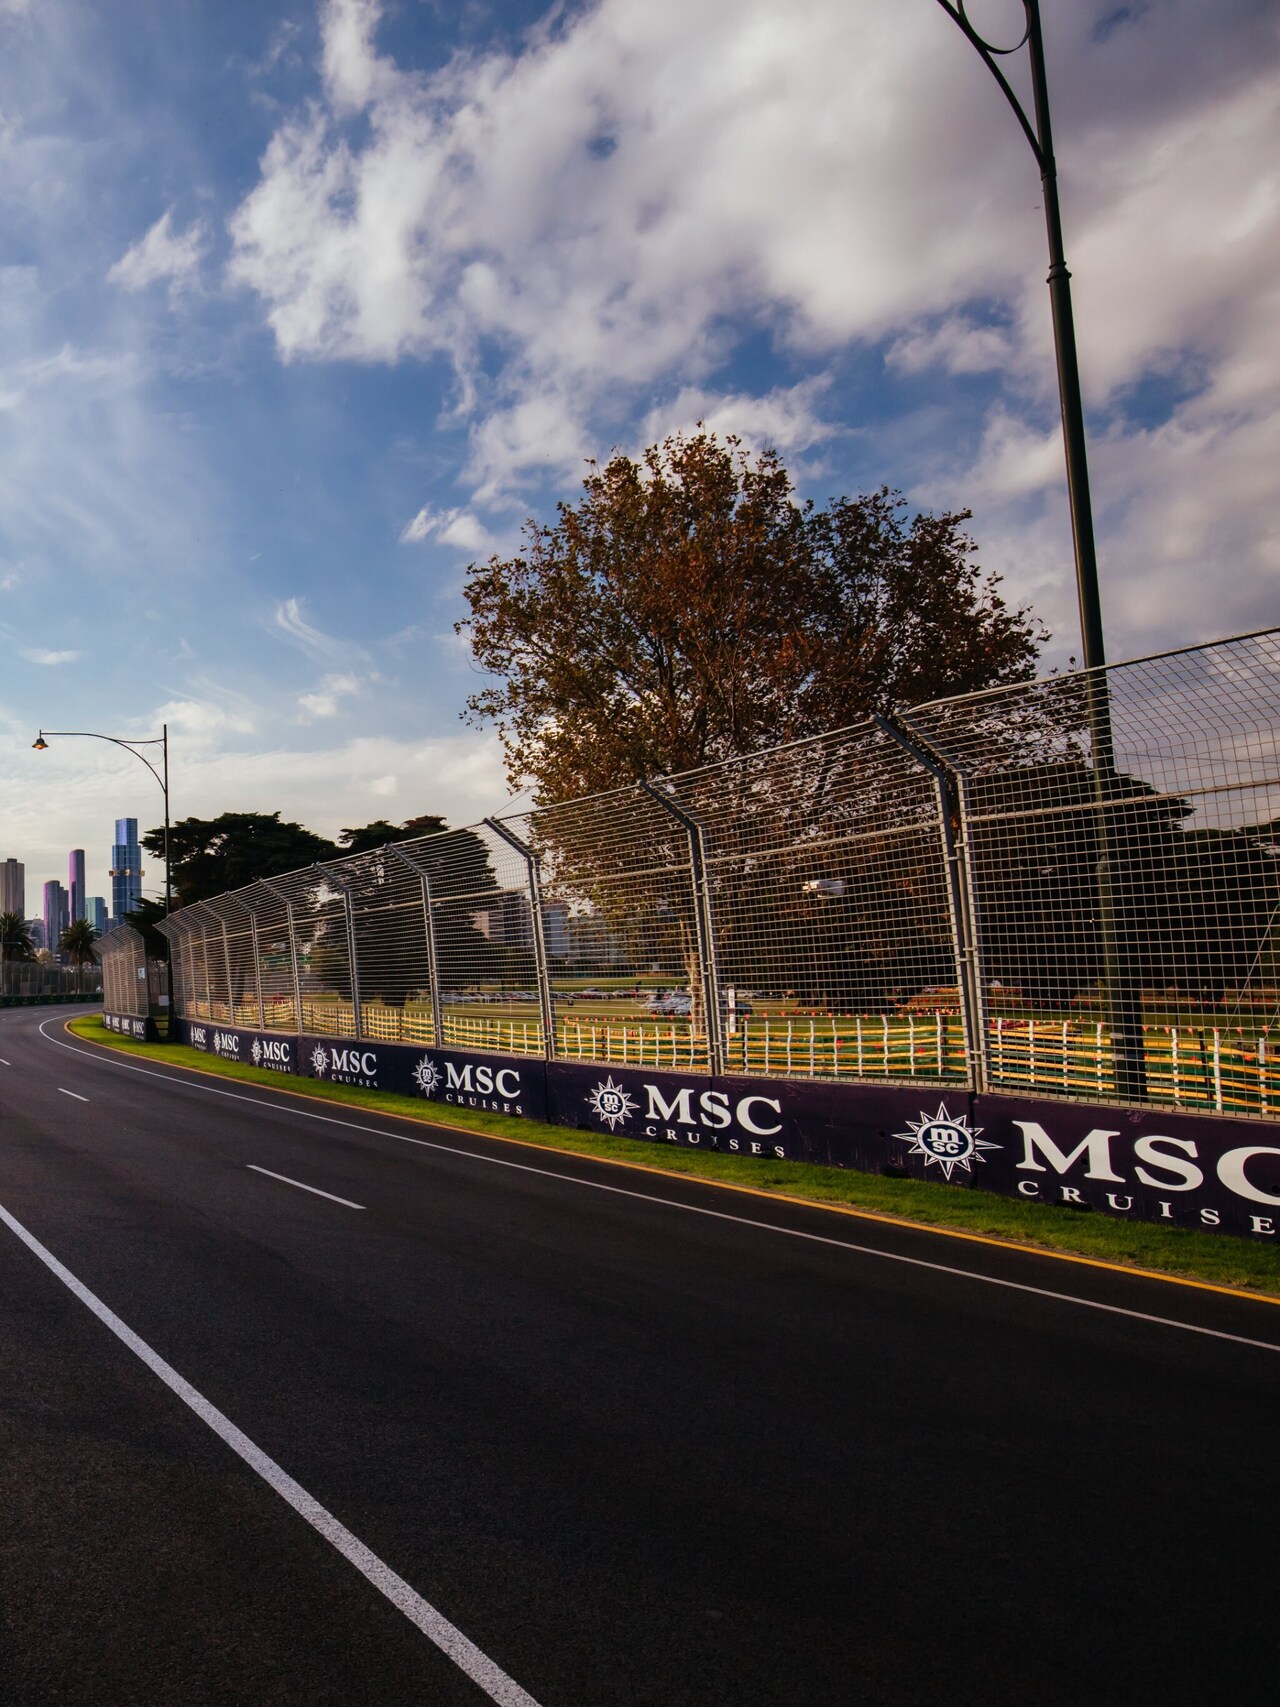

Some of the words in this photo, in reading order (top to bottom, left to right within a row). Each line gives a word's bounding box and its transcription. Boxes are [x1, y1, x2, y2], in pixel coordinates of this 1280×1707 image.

[194, 1027, 206, 1043] MSC
[221, 1033, 239, 1052] MSC
[263, 1041, 290, 1062] MSC
[331, 1049, 376, 1075] MSC
[332, 1074, 378, 1087] CRUISES
[444, 1062, 520, 1098] MSC
[446, 1094, 522, 1114] CRUISES
[643, 1084, 783, 1135] MSC
[646, 1126, 785, 1158] CRUISES
